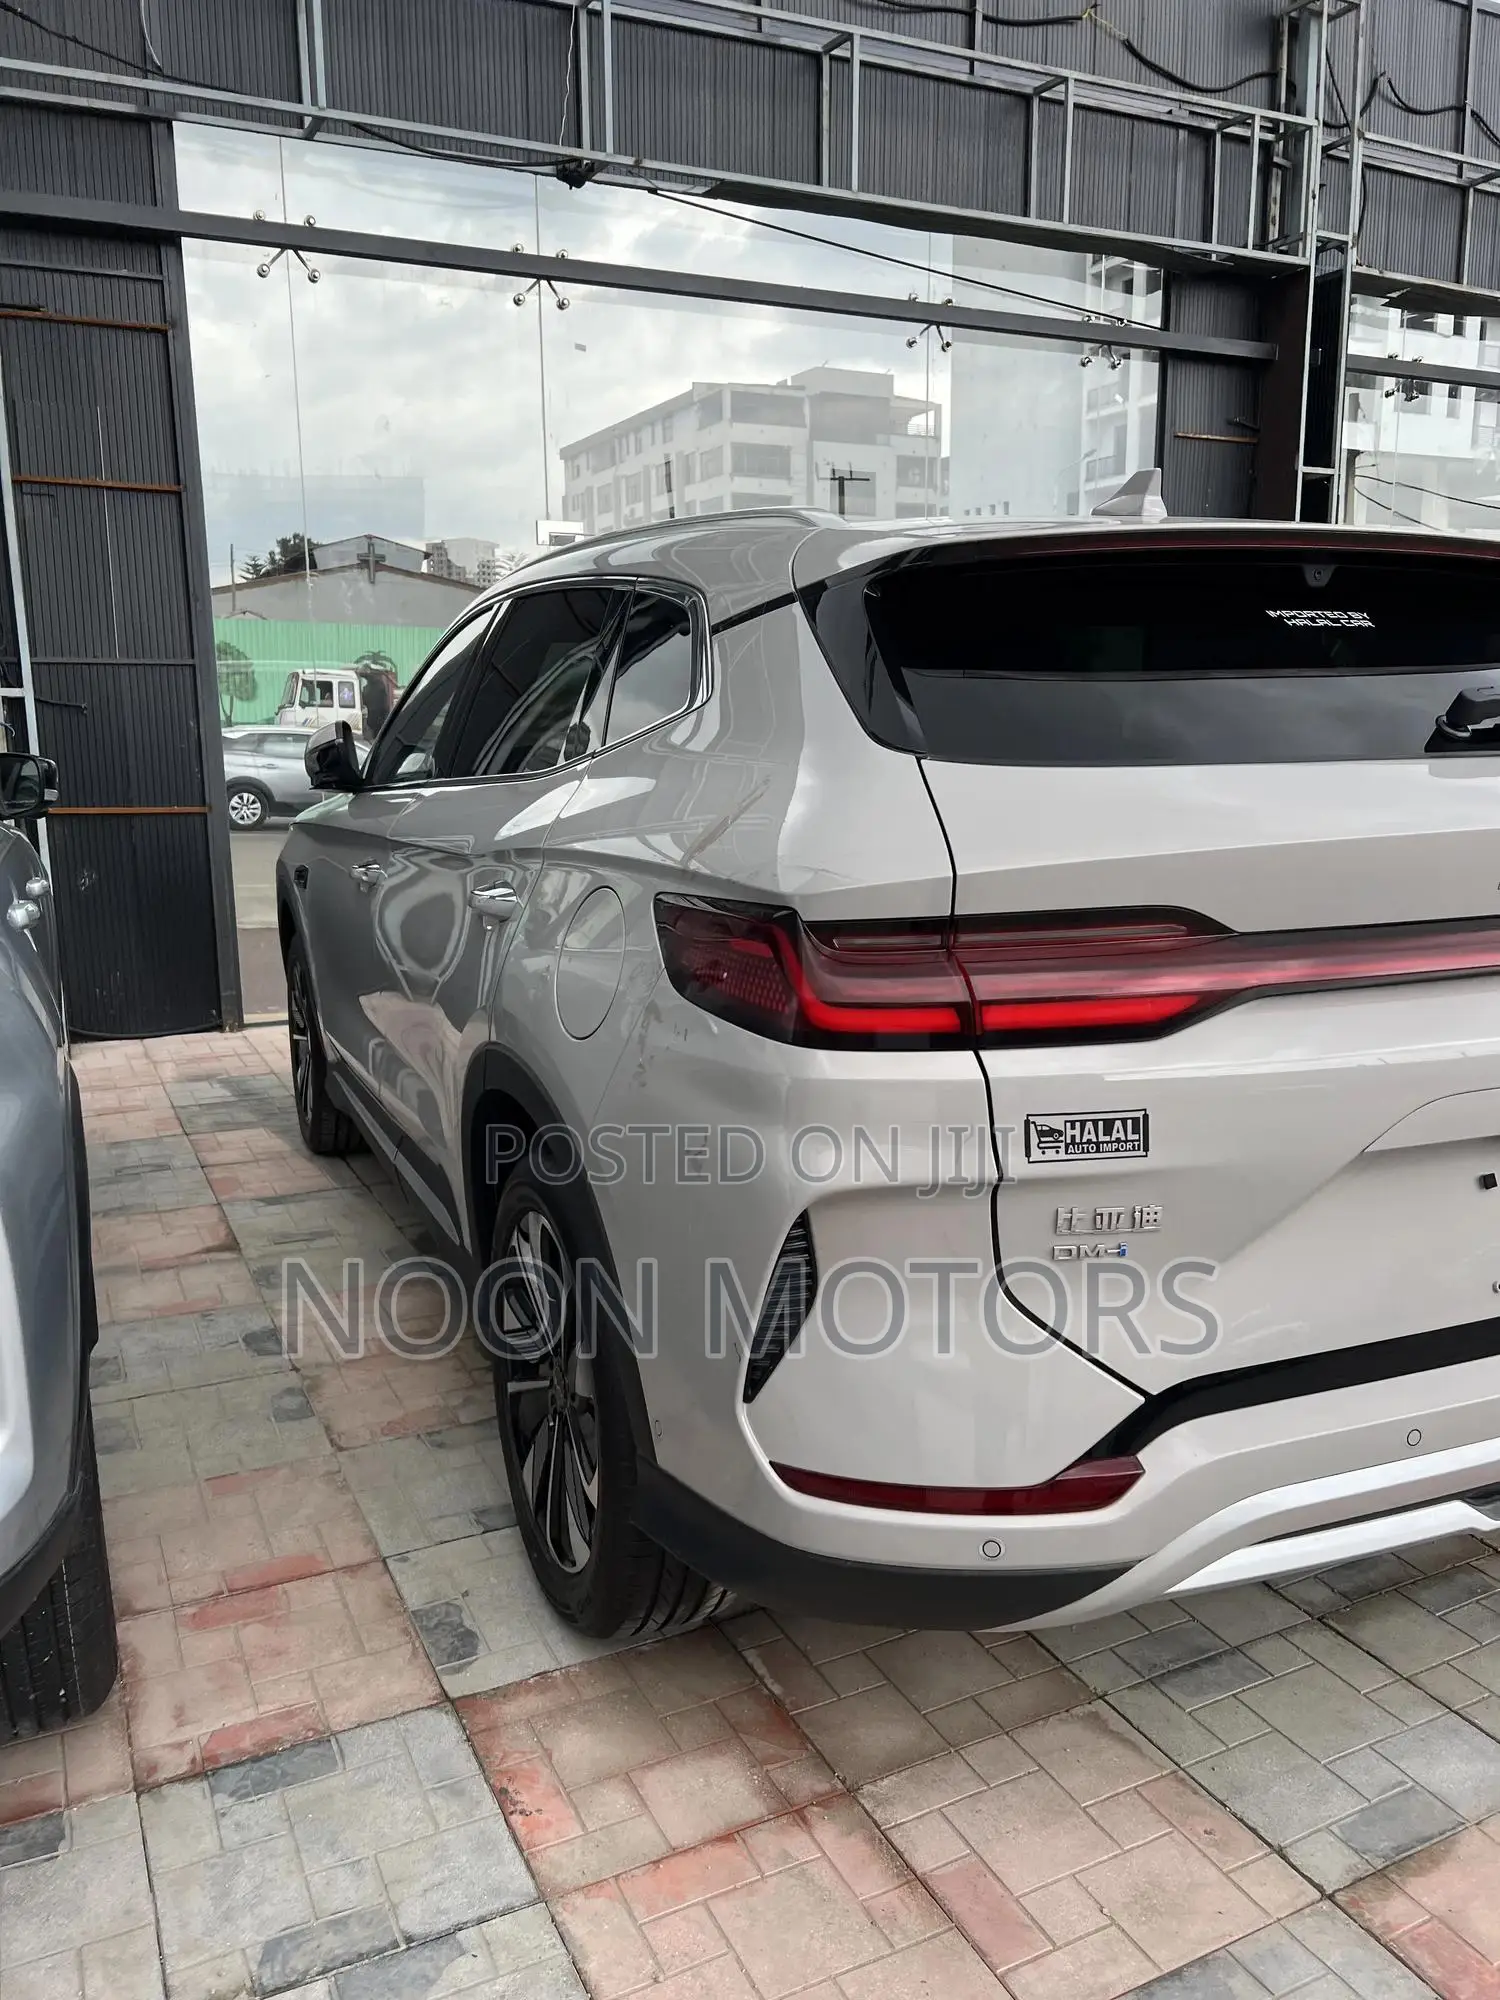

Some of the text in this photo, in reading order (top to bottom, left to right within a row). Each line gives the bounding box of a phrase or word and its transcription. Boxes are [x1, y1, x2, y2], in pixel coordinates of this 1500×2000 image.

[1265, 610, 1370, 619] IMPORTED BY
[1284, 619, 1342, 627] HALAL
[1065, 1119, 1140, 1143] HALAL
[1067, 1141, 1140, 1154] AUTO IMPORT
[1055, 1204, 1163, 1236] 比亚迪
[1053, 1242, 1128, 1261] DM-i
